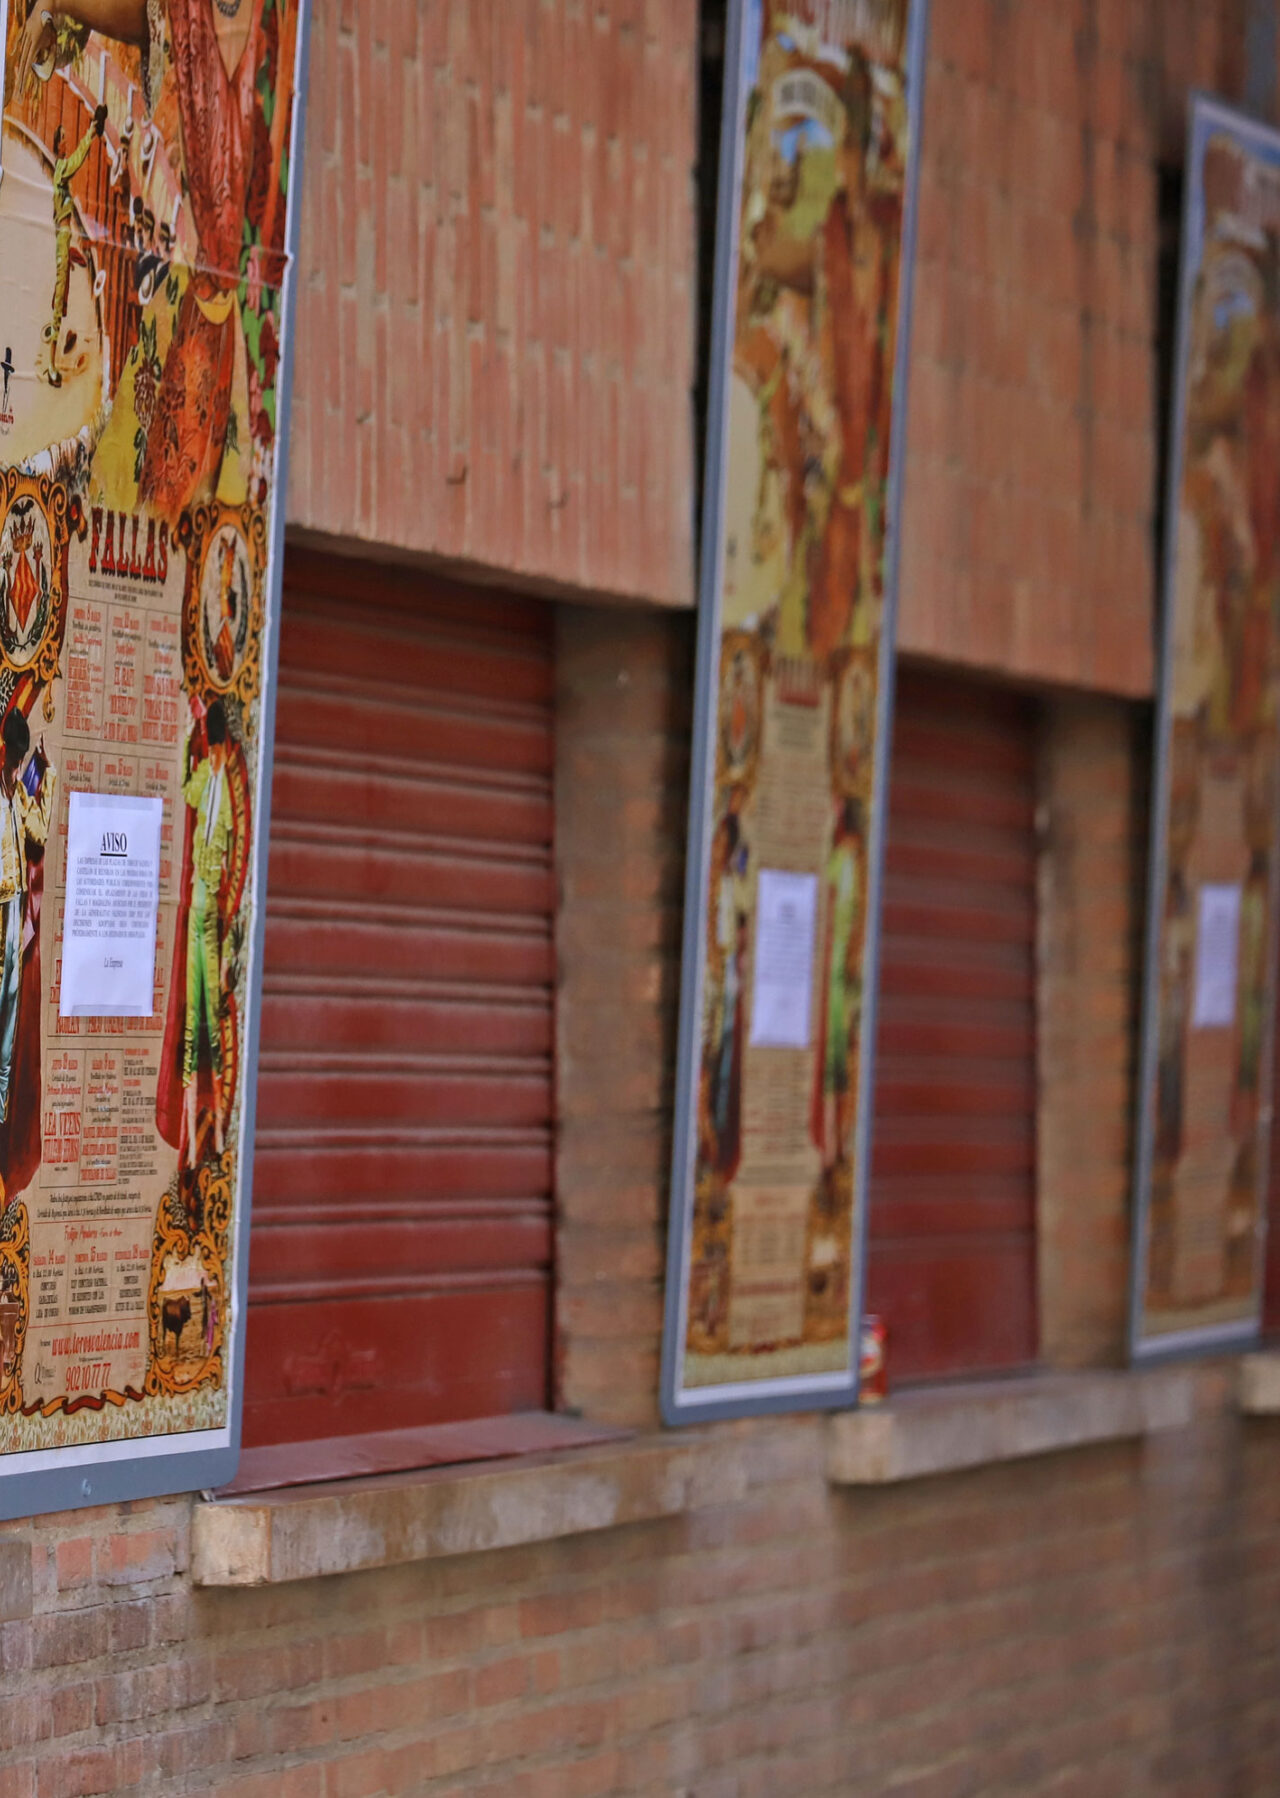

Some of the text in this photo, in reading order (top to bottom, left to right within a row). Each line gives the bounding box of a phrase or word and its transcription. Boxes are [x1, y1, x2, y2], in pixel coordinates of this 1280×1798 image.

[89, 506, 169, 585] FALLAS
[101, 832, 127, 853] AVISO
[52, 1327, 140, 1356] www.torosvalencia.com
[65, 1366, 81, 1392] 902
[81, 1365, 91, 1390] 10
[91, 1363, 102, 1389] 77
[102, 1362, 111, 1387] 77
